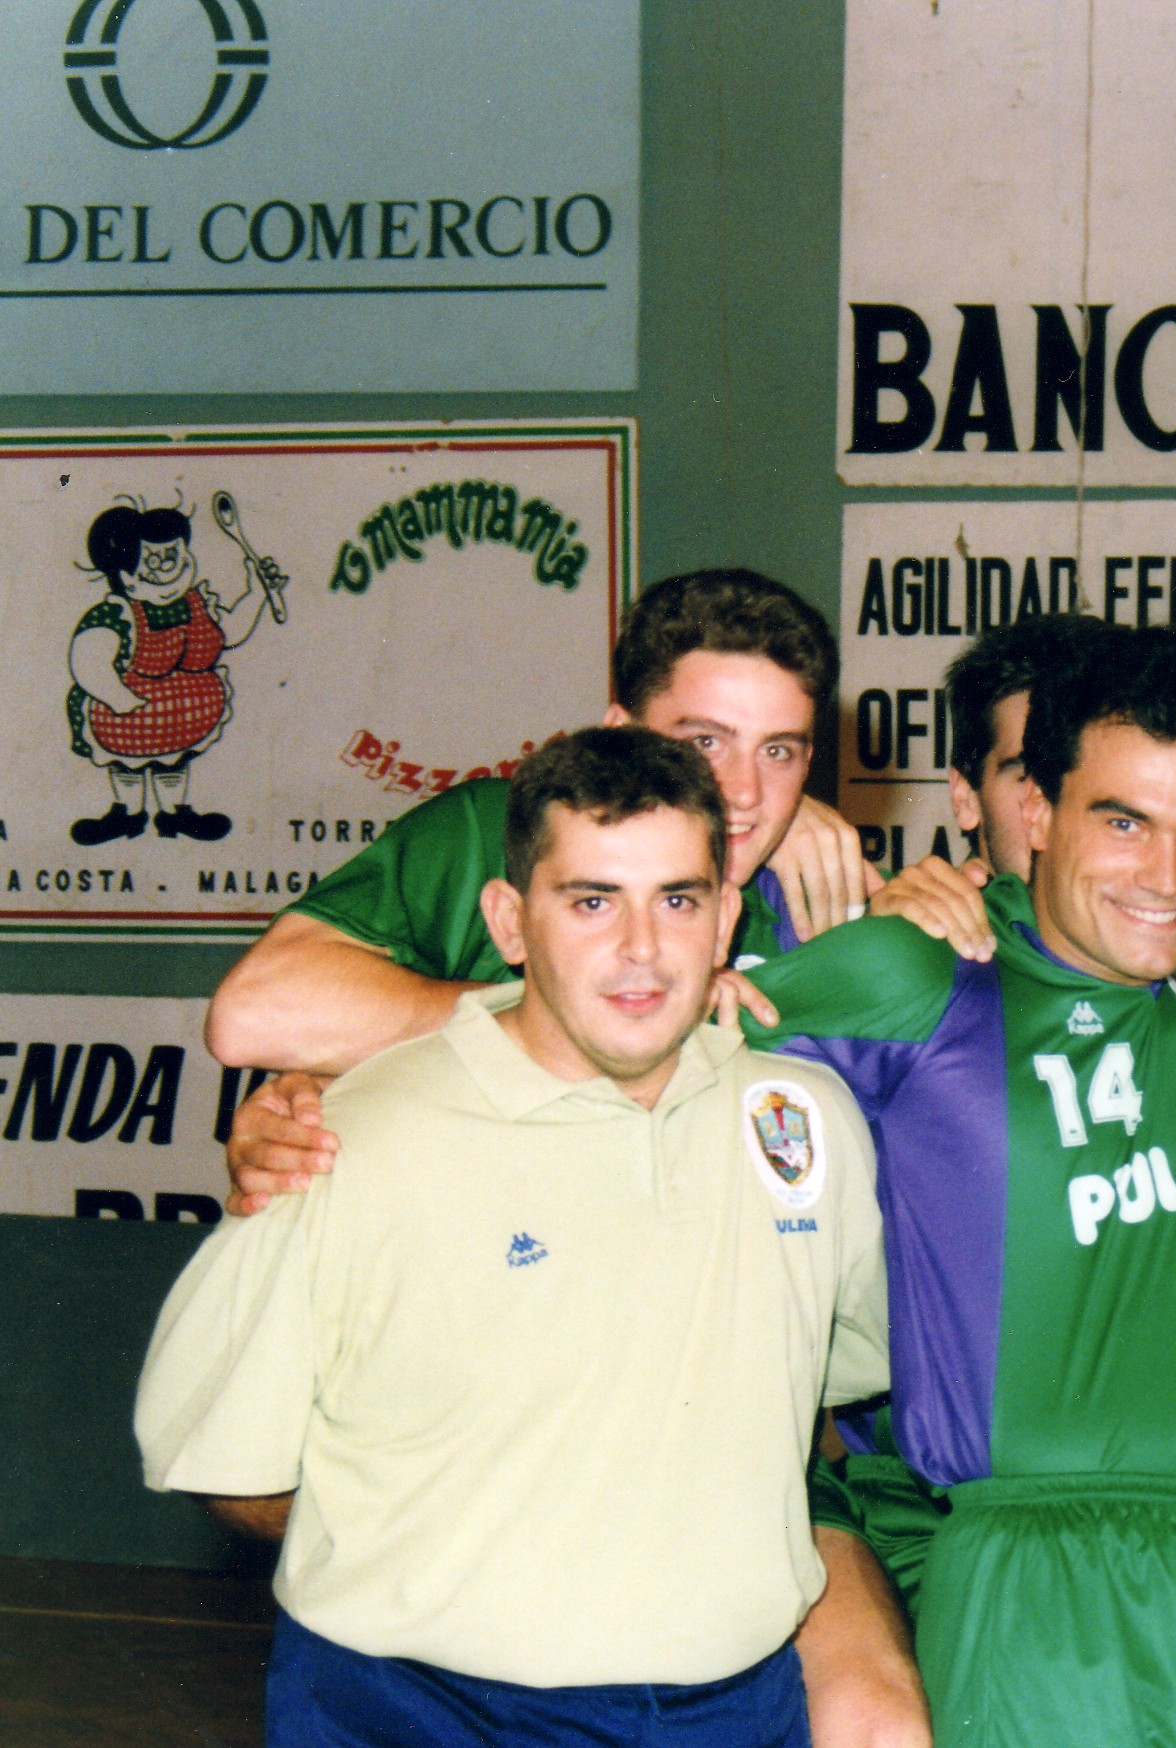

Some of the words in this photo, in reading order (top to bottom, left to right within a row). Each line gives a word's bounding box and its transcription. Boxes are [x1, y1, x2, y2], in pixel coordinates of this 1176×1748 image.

[24, 204, 172, 265] DEL
[199, 193, 614, 264] COMERCIO
[857, 554, 1078, 637] AGILIDAD
[35, 868, 135, 893] COSTA
[198, 870, 321, 895] MALAGA
[1033, 1041, 1144, 1148] 14
